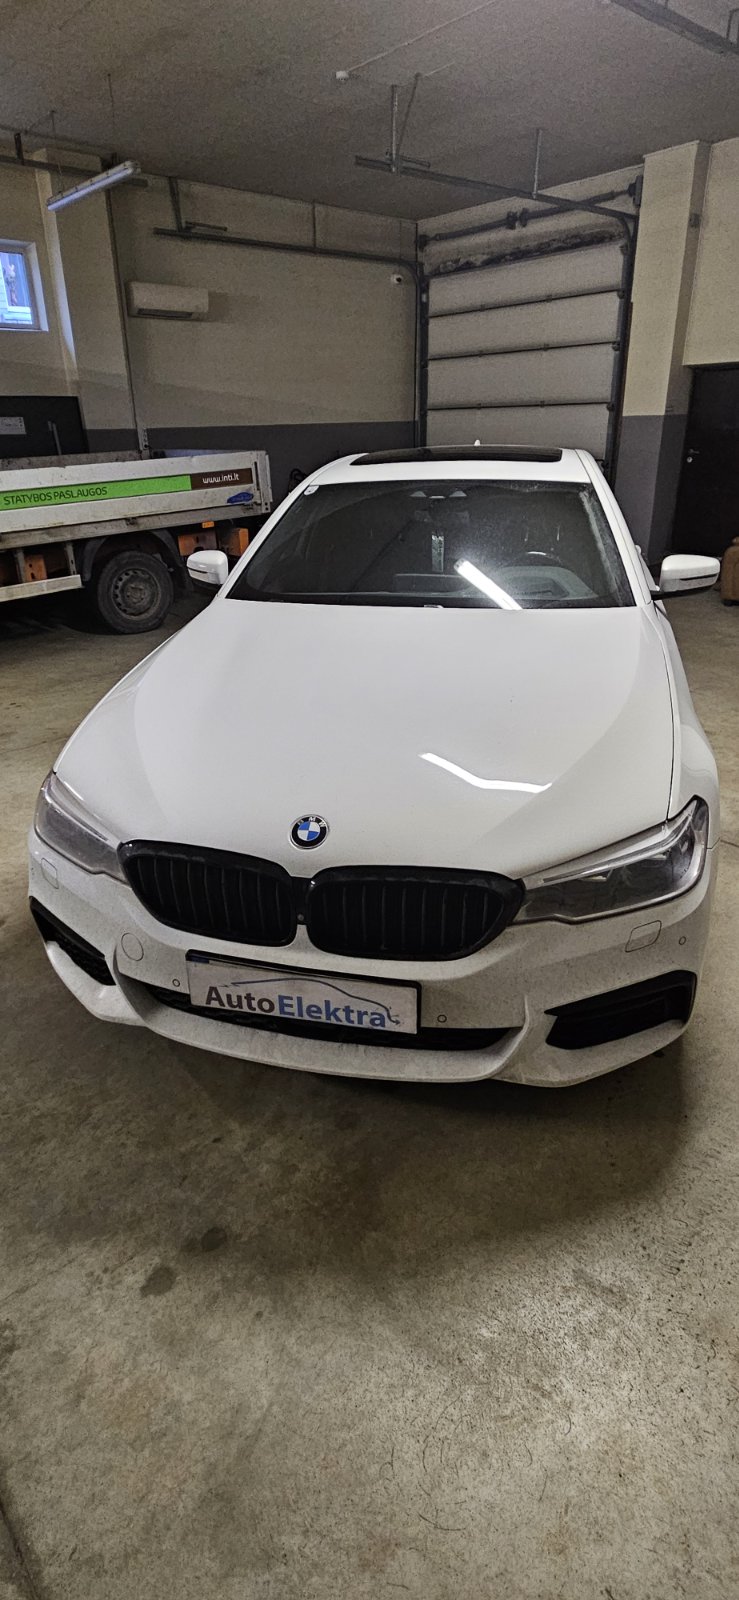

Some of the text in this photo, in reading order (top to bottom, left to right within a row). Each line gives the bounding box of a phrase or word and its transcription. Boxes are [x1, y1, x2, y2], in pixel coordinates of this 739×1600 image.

[202, 473, 240, 484] www.inti.lt
[3, 486, 108, 506] STATYBOS PASLAUGOS
[205, 985, 387, 1029] AutoElektra
